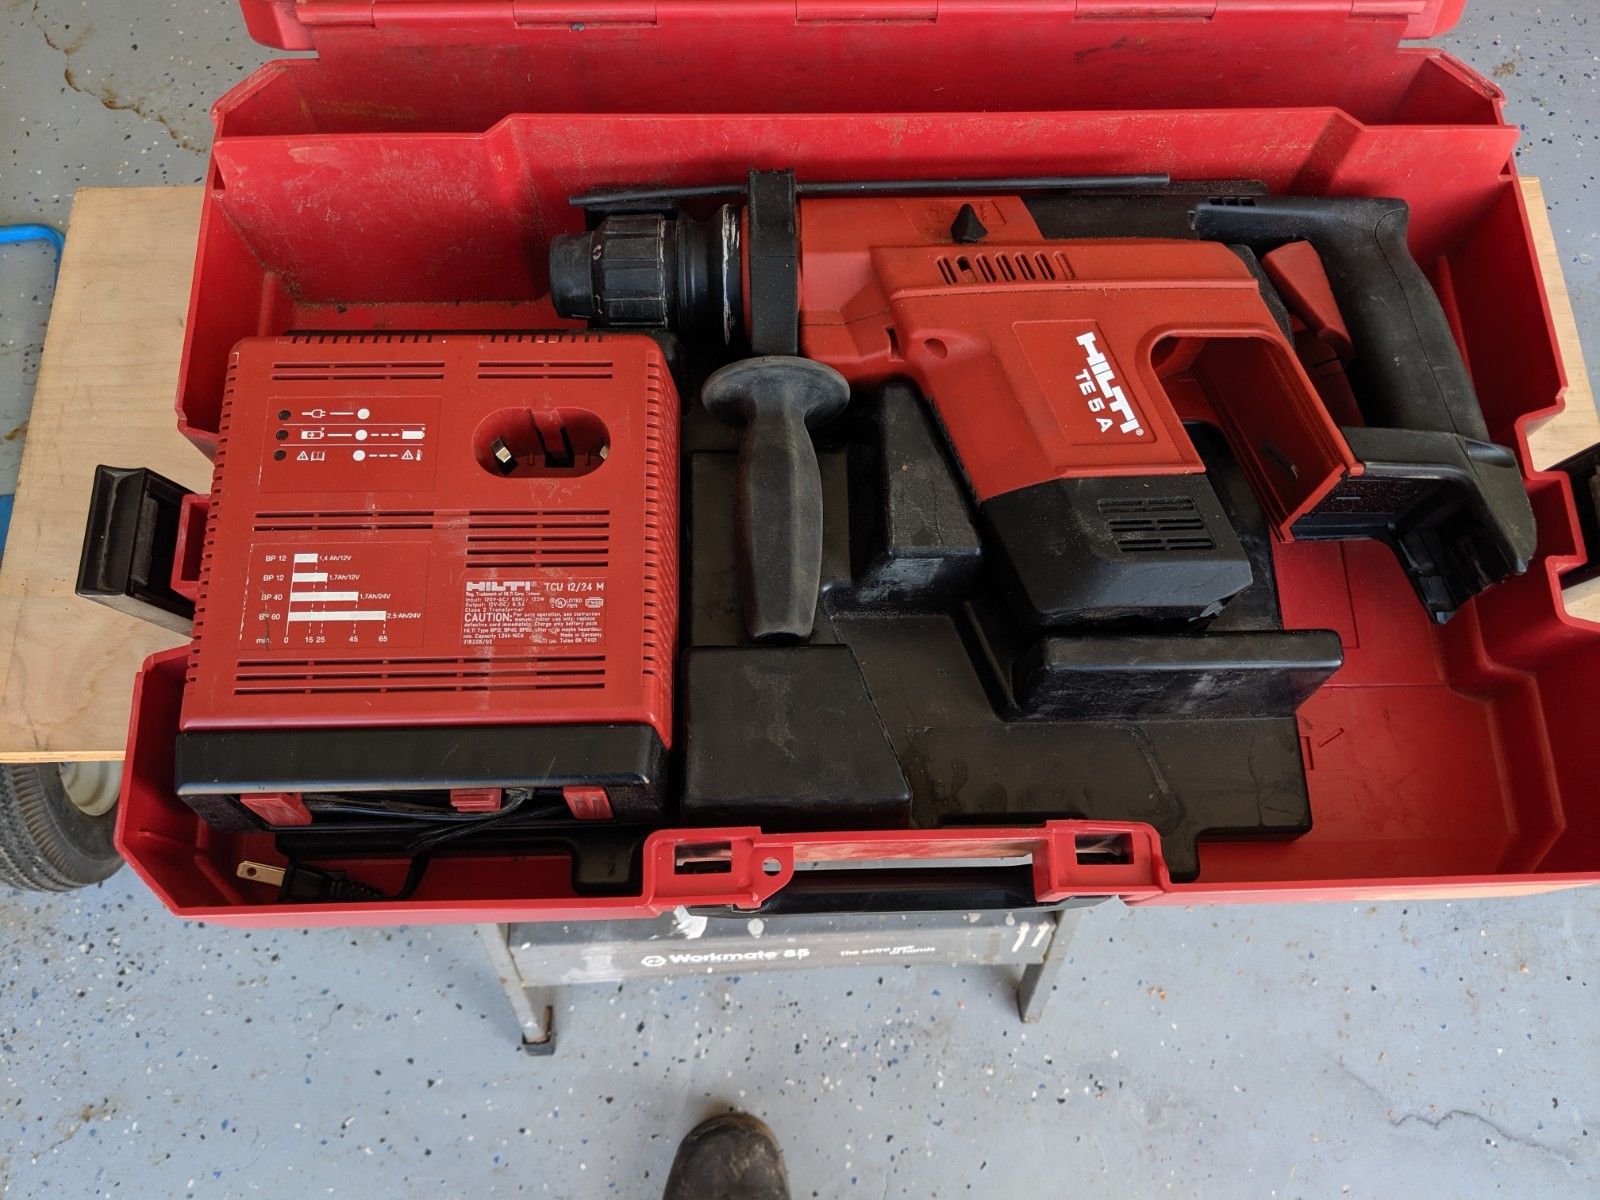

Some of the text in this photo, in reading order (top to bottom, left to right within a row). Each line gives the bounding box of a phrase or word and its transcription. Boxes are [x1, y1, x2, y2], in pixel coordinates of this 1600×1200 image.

[1076, 332, 1140, 434] HILTI
[1075, 369, 1113, 433] TE 5 A
[466, 581, 531, 592] HILTI
[543, 582, 605, 592] TCU 12/24 M
[464, 612, 512, 622] CAUTION:
[669, 951, 778, 964] Workmate
